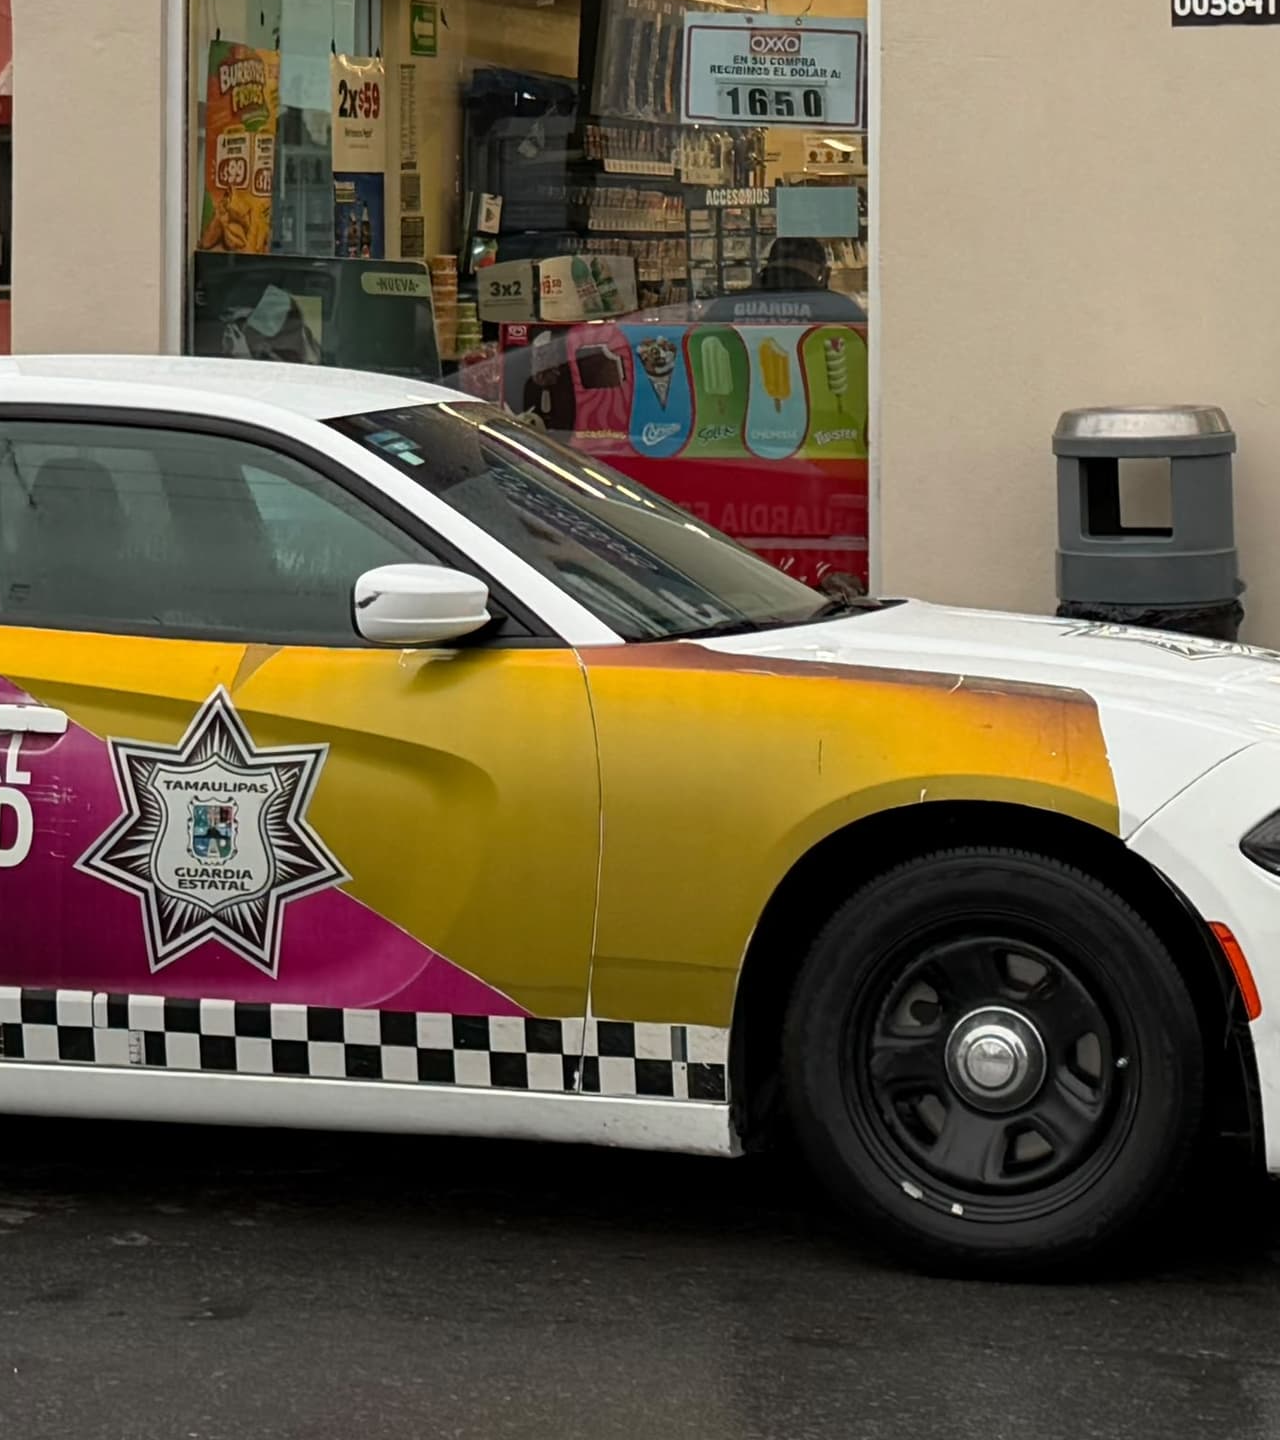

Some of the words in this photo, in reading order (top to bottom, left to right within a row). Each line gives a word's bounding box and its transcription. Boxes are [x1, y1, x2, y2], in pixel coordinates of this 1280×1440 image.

[750, 35, 801, 54] OXXO
[732, 55, 748, 66] EN
[752, 56, 767, 66] SU
[770, 57, 817, 68] COMPRA
[773, 66, 787, 77] EL
[337, 79, 381, 120] 2x$59
[705, 188, 771, 207] ACCESORIOS
[489, 280, 523, 297] 3x2
[733, 302, 812, 317] GUARDIA
[162, 779, 270, 795] TAMAULIPAS
[173, 866, 253, 882] GUARDIA
[176, 878, 252, 893] ESTATAL
